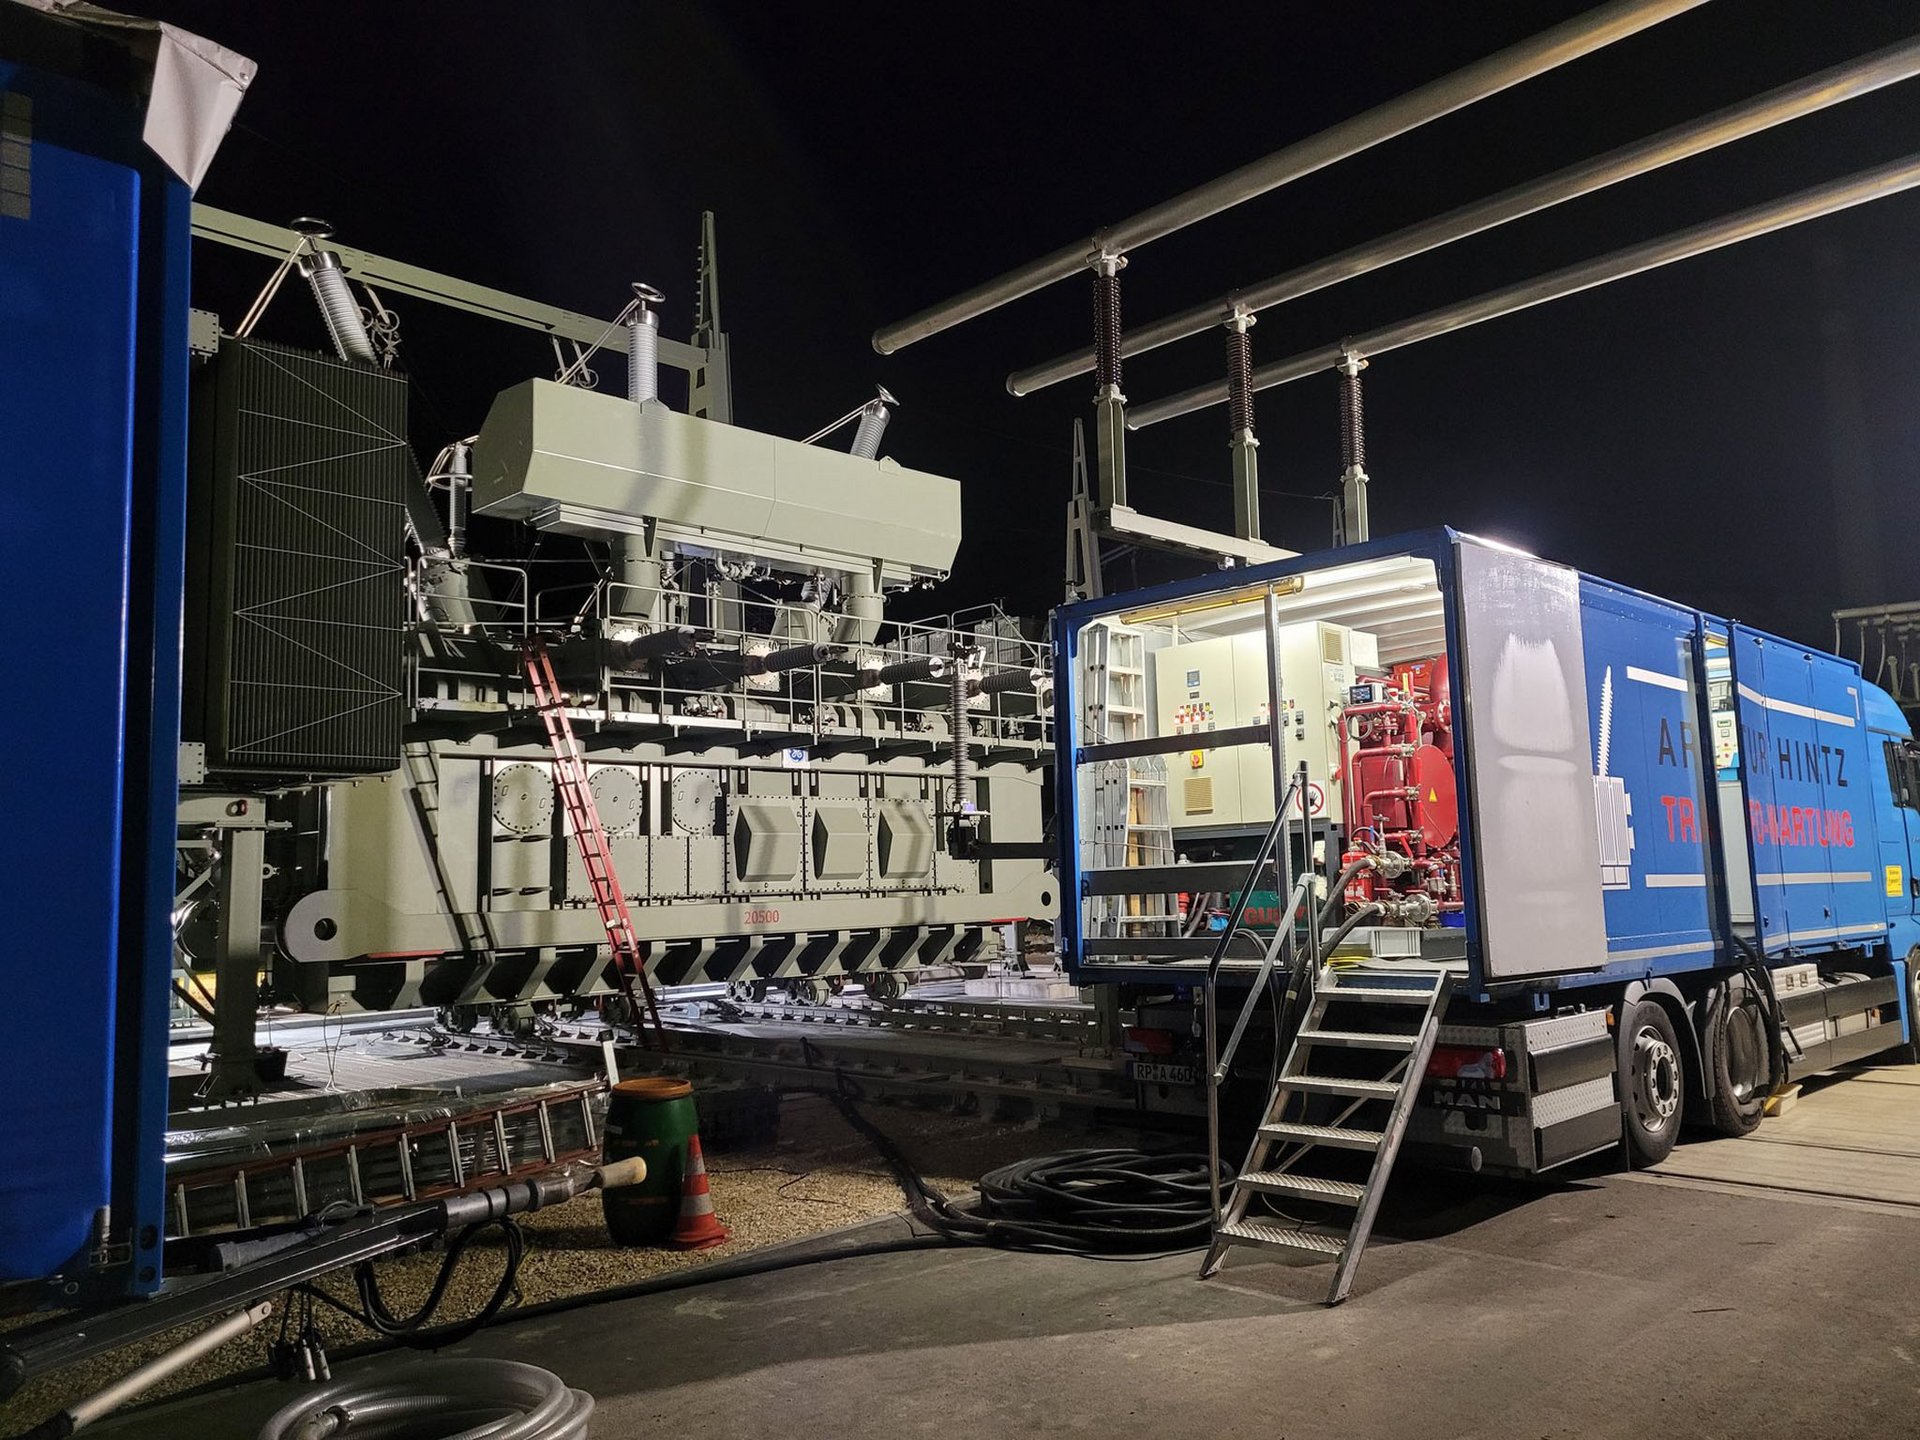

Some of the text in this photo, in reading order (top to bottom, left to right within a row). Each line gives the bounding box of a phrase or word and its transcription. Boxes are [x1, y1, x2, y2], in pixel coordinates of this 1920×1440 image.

[1777, 737, 1848, 787] HINTZ
[744, 910, 779, 924] 20500
[1136, 1063, 1152, 1079] RP
[1159, 1066, 1167, 1080] A
[1433, 1087, 1501, 1110] MAN
